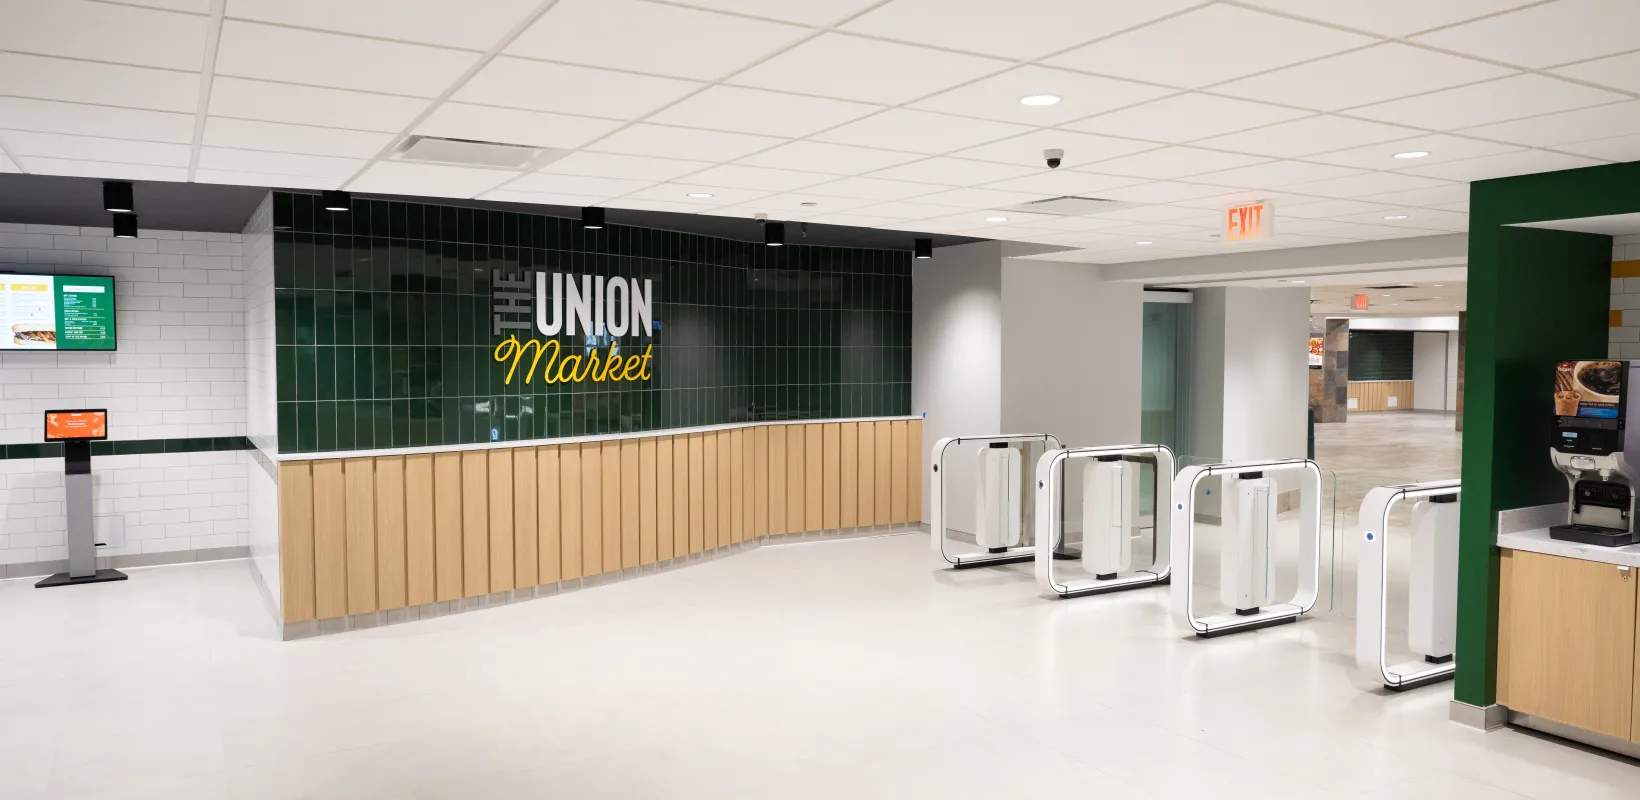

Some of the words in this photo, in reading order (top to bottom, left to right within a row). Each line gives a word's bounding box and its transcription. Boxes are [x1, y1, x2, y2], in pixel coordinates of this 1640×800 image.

[1228, 205, 1263, 240] EXIT
[492, 269, 532, 336] THE
[536, 271, 652, 337] UNION
[494, 334, 653, 385] Market
